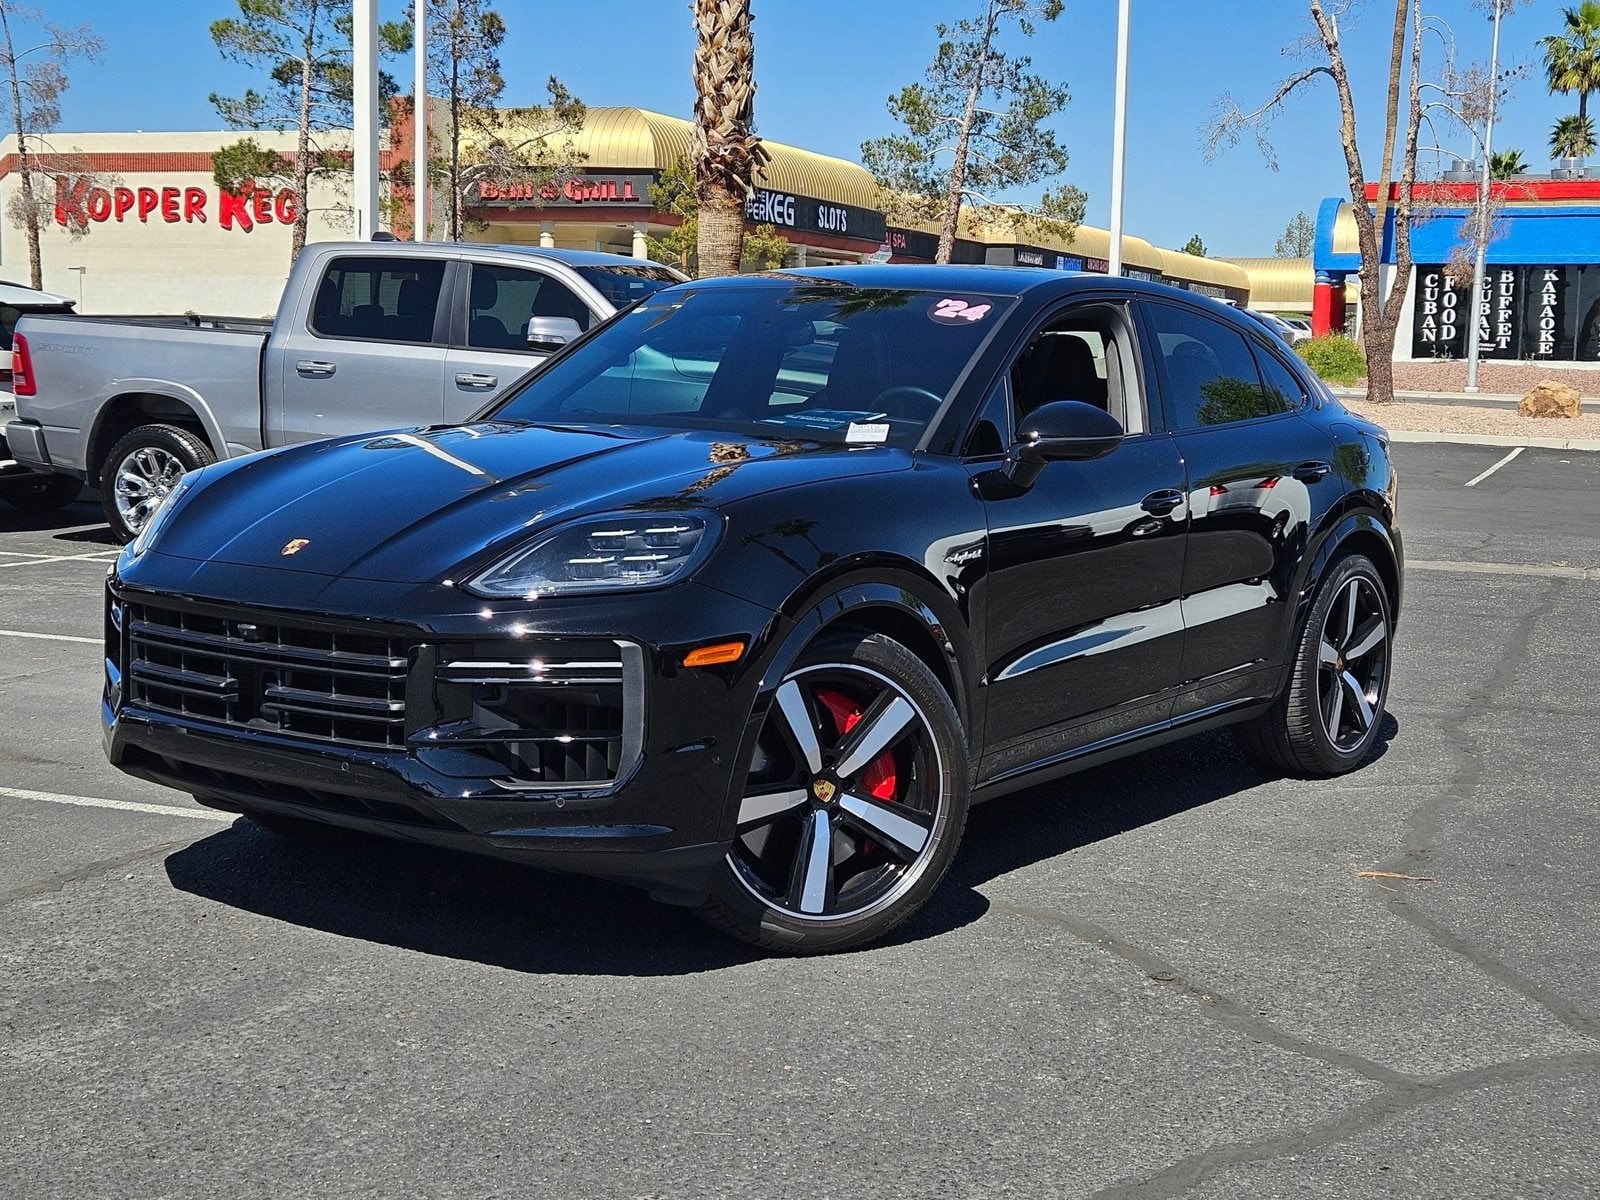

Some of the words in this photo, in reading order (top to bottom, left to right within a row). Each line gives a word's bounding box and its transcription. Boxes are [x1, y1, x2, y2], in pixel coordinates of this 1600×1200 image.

[55, 175, 207, 228] KOPPER
[219, 178, 297, 233] KEG
[564, 177, 639, 203] GRILL
[765, 191, 795, 226] KEG
[818, 205, 847, 232] SLOTS
[892, 233, 906, 248] SPA
[1421, 274, 1439, 342] CUBAN
[1440, 275, 1457, 341] FOOD
[1478, 276, 1493, 341] CUBAN
[1496, 270, 1515, 349] BUFFET
[1538, 269, 1559, 354] KARAOKE
